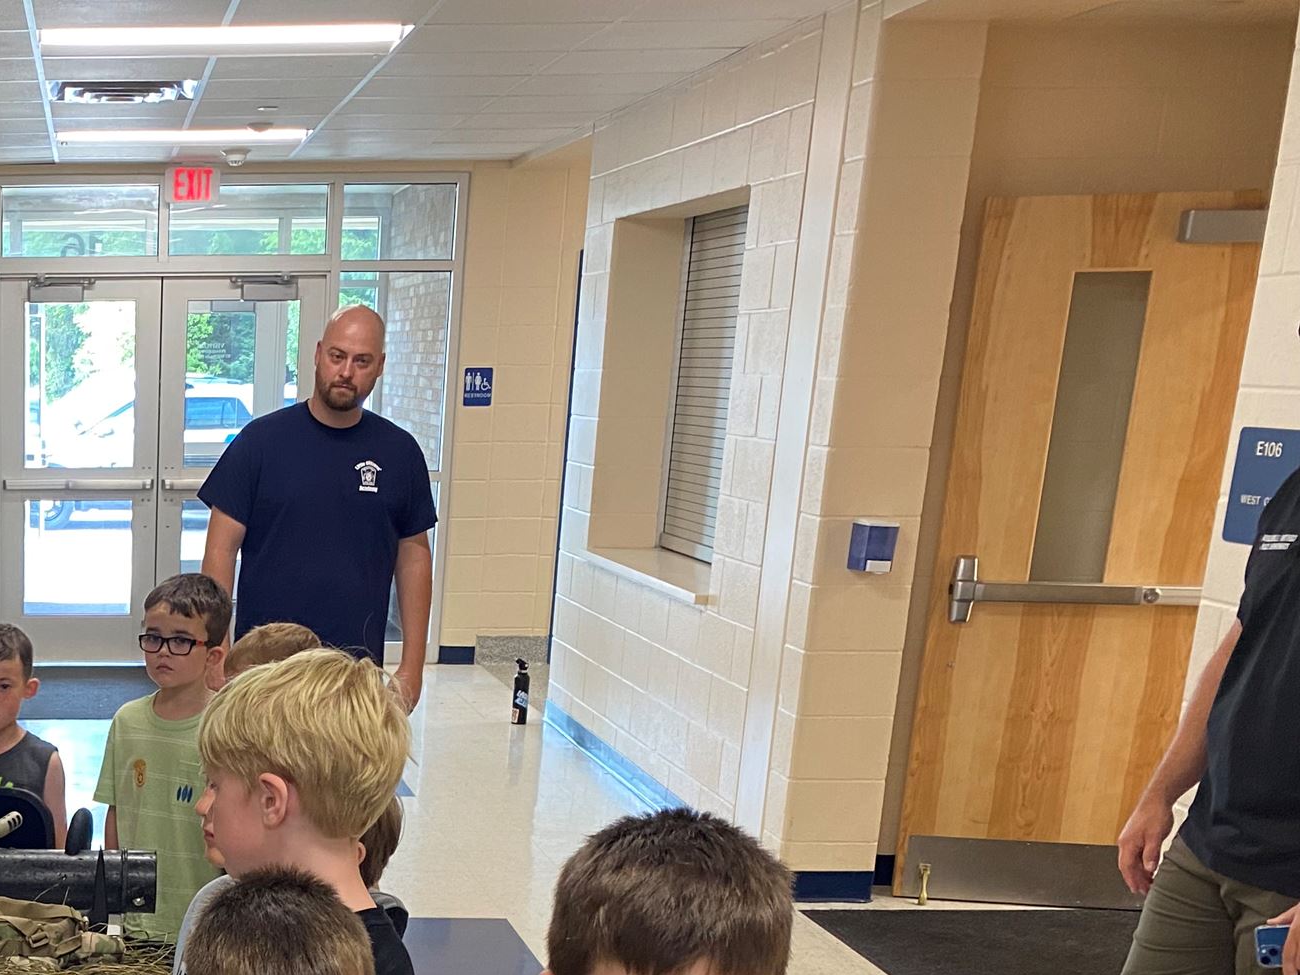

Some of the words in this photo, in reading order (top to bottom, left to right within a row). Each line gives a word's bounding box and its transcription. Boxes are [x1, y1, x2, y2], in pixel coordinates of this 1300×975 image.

[173, 166, 214, 202] EXIT
[1255, 441, 1283, 457] E106
[1240, 494, 1261, 505] WEST
